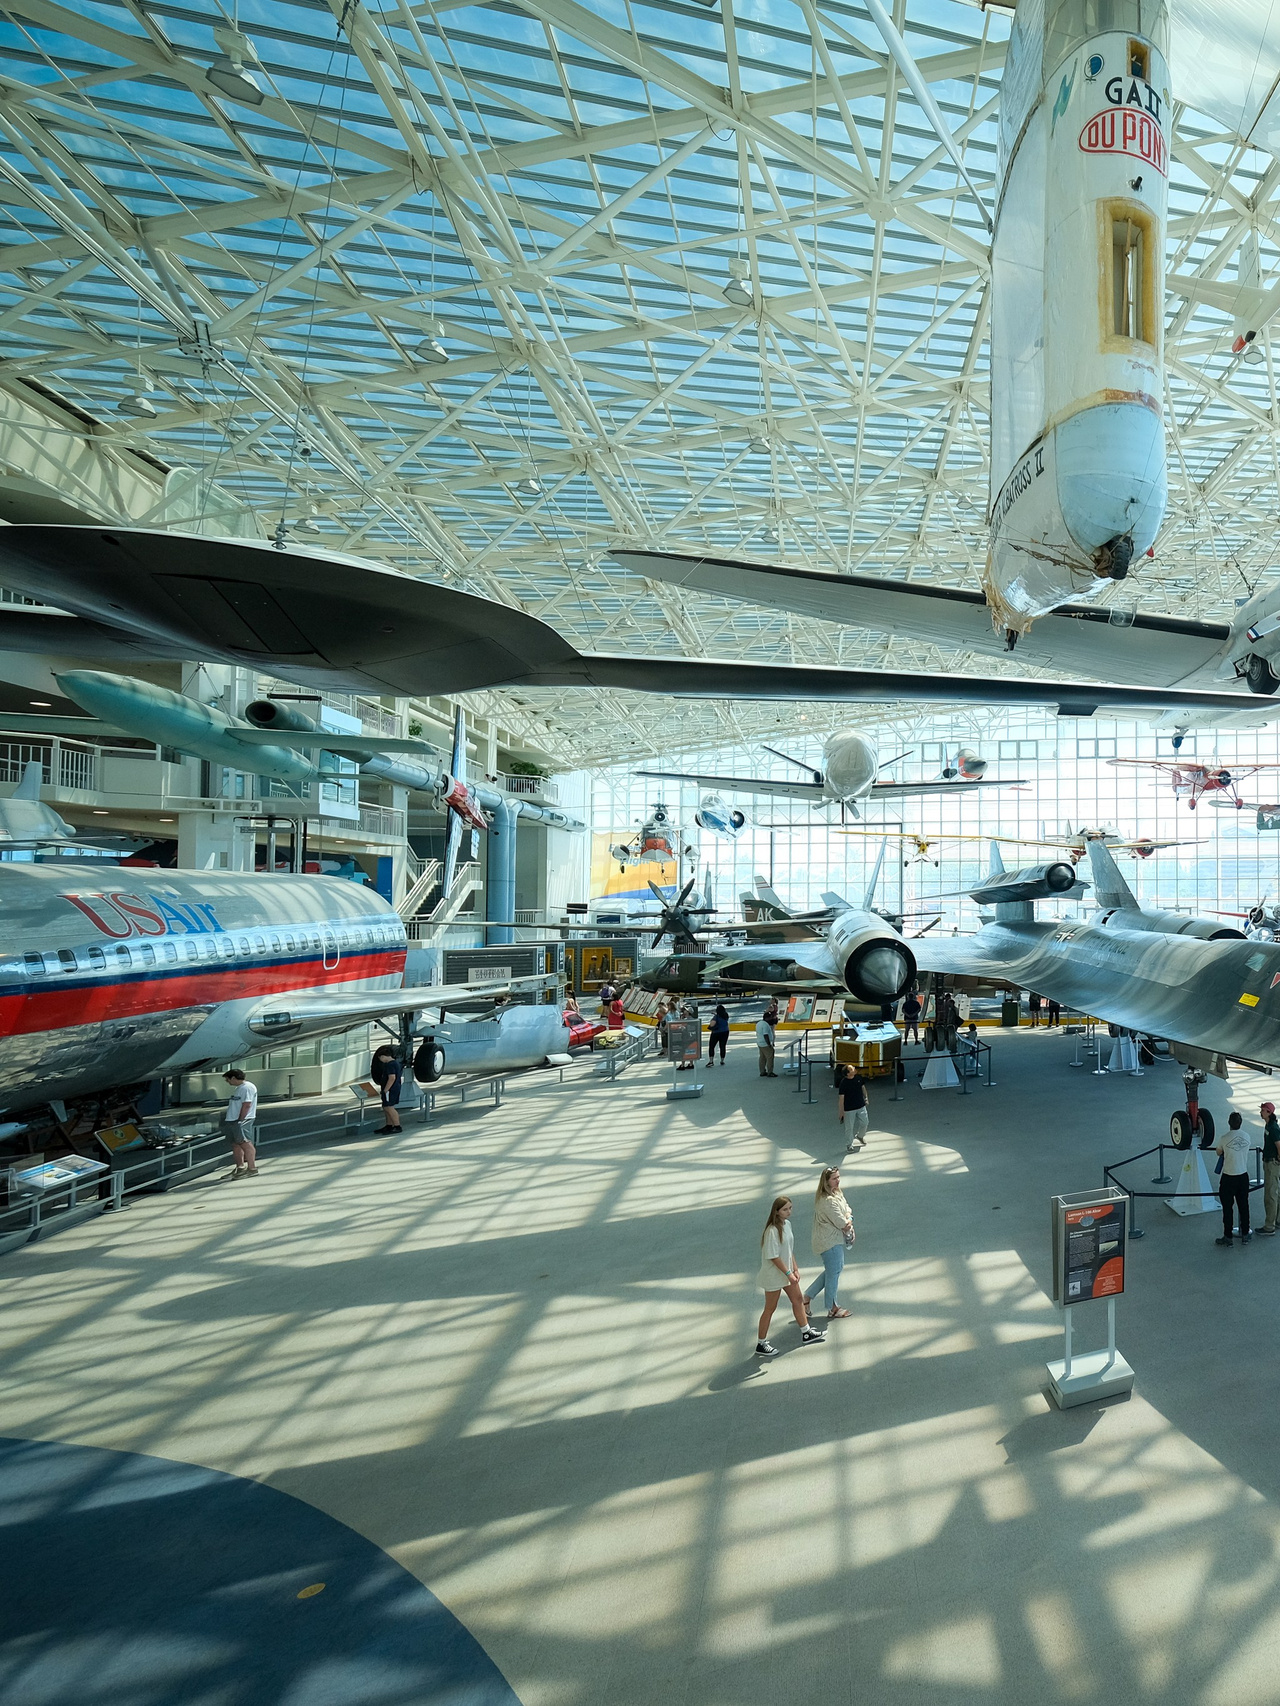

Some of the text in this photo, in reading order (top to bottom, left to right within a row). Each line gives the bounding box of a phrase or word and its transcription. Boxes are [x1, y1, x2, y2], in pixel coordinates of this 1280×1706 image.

[1105, 76, 1142, 107] GA
[1034, 446, 1045, 478] II
[56, 889, 227, 938] USAir
[756, 907, 777, 922] AK
